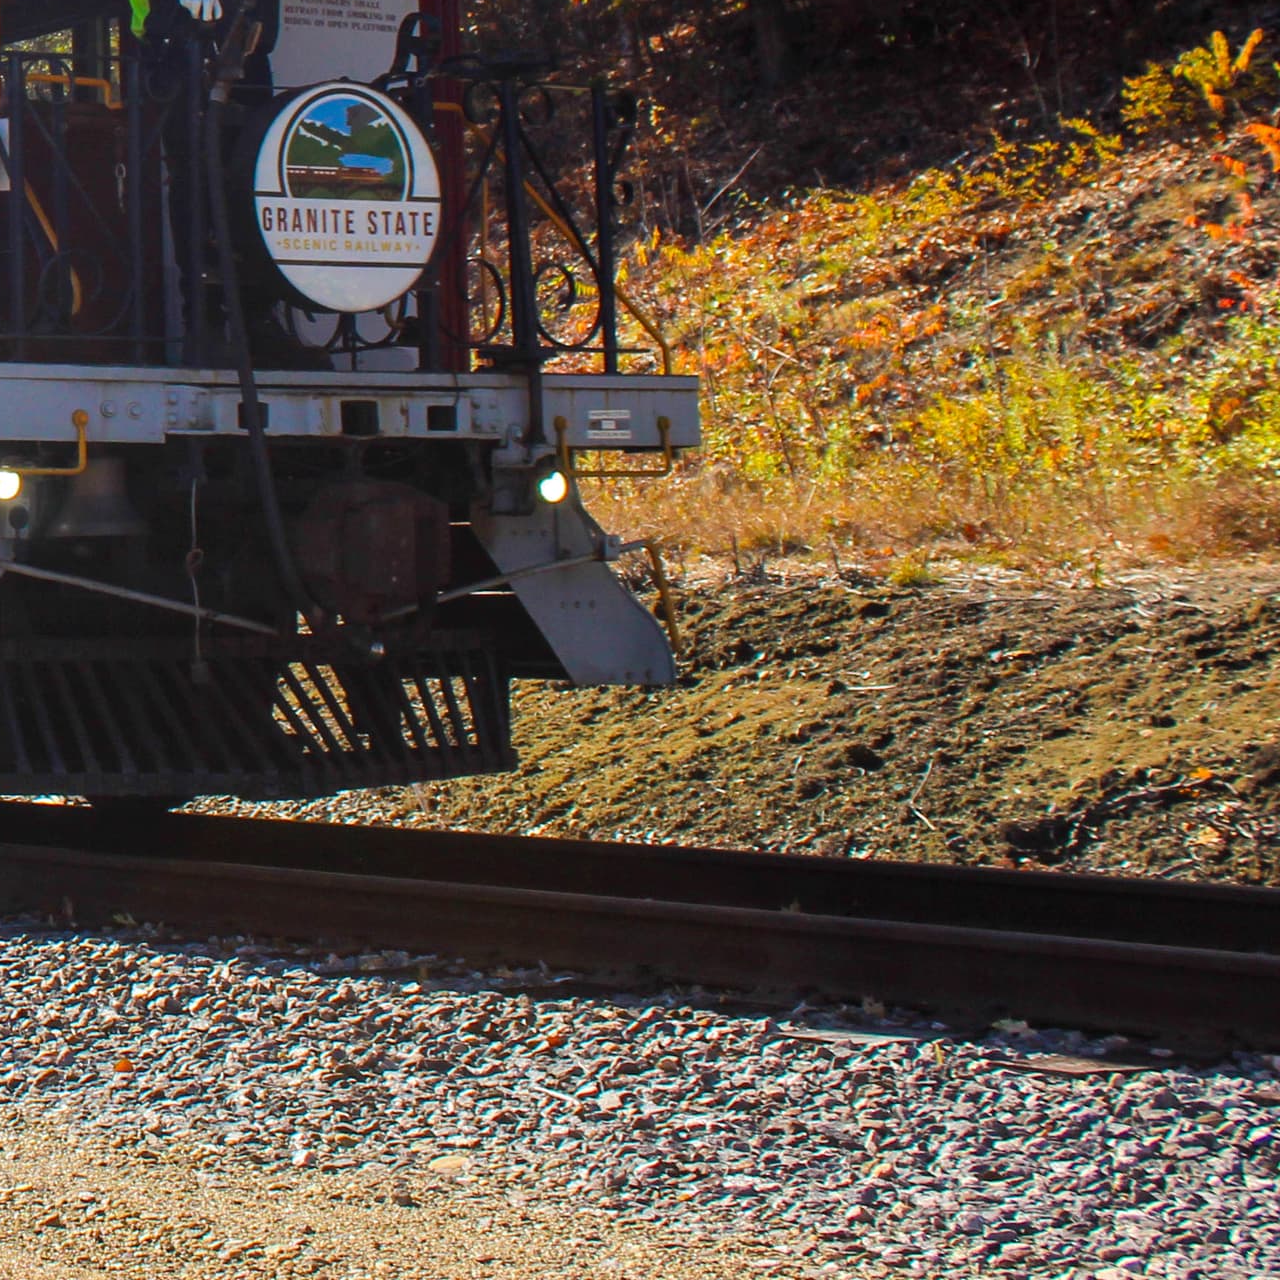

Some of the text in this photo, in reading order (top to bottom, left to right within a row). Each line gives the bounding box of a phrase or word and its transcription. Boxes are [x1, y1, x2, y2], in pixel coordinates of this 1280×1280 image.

[261, 206, 434, 237] GRANITE STATE
[282, 238, 412, 253] SCENIC RAILWAY
